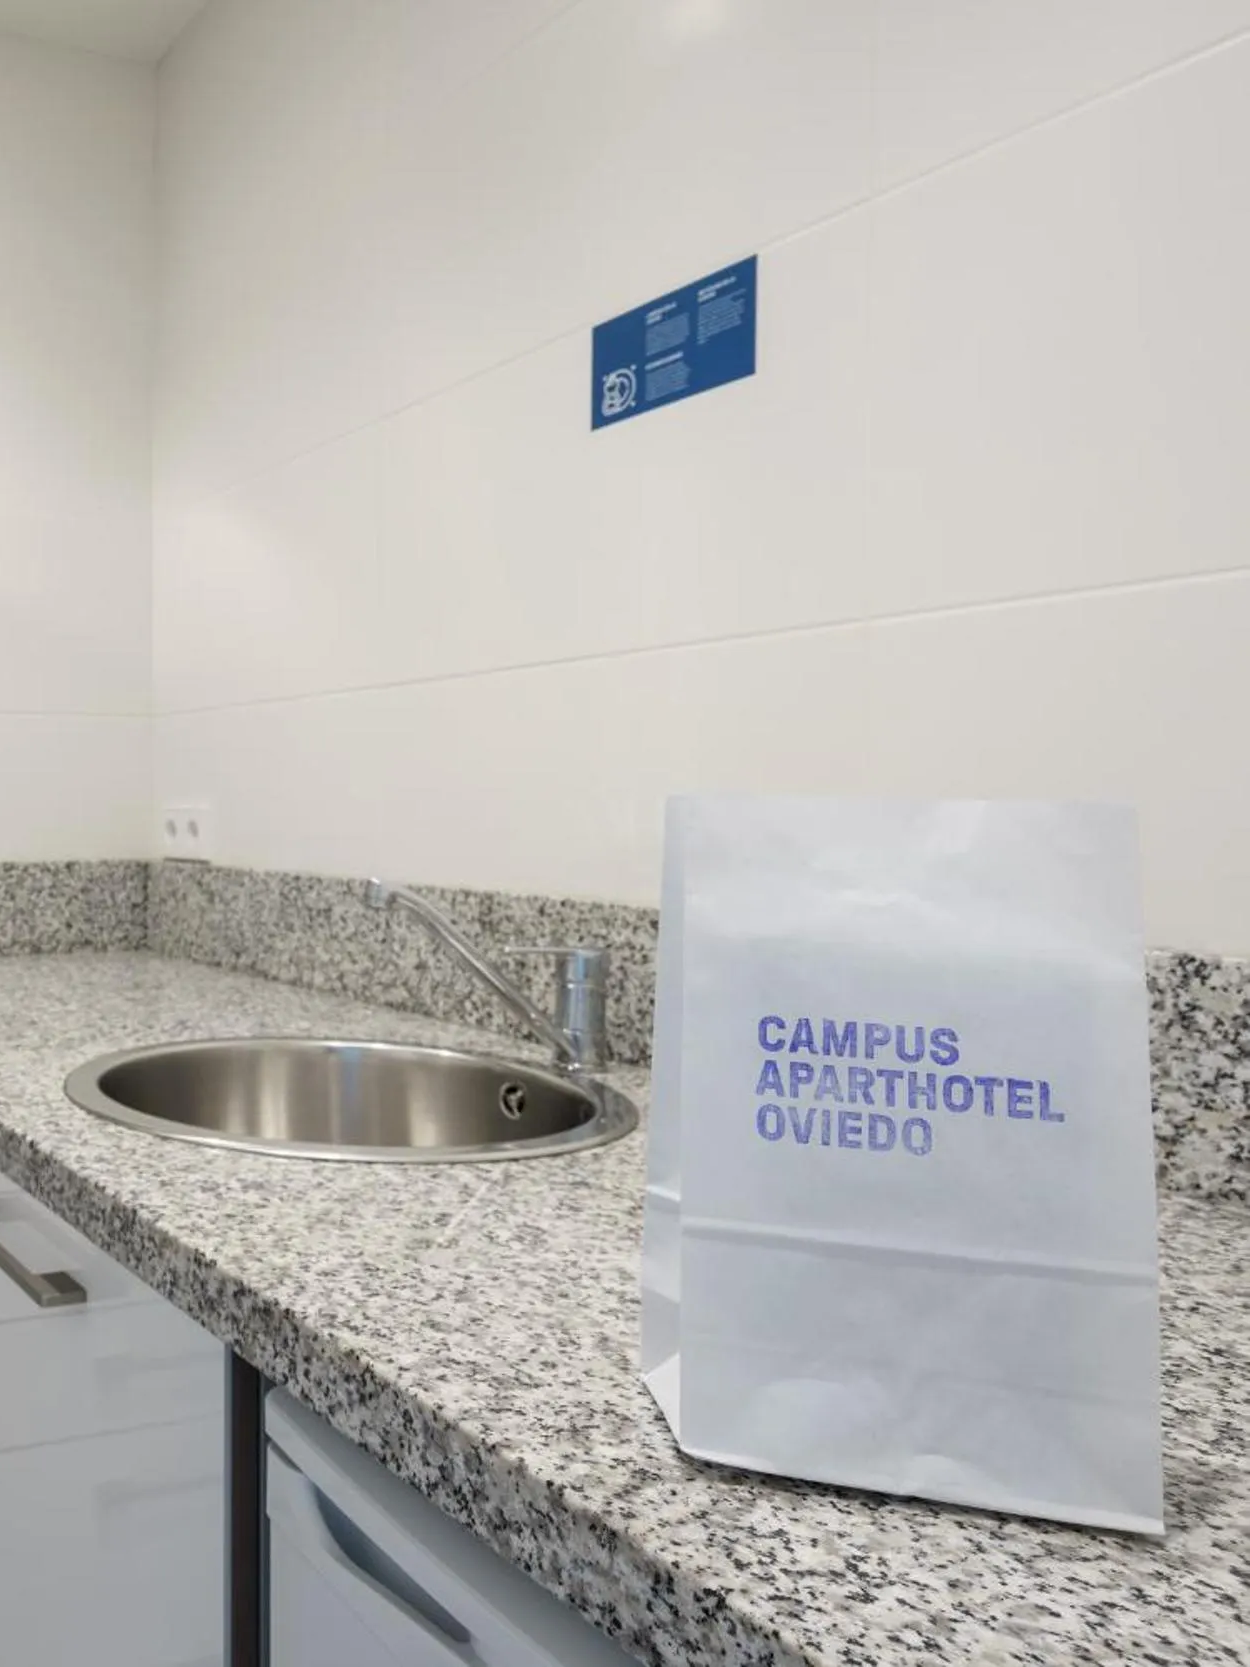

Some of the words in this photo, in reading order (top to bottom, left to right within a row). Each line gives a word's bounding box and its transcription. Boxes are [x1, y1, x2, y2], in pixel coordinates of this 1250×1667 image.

[757, 1015, 960, 1066] CAMPUS
[756, 1059, 1065, 1122] APARTHOTEL
[756, 1103, 933, 1157] OVIEDO
